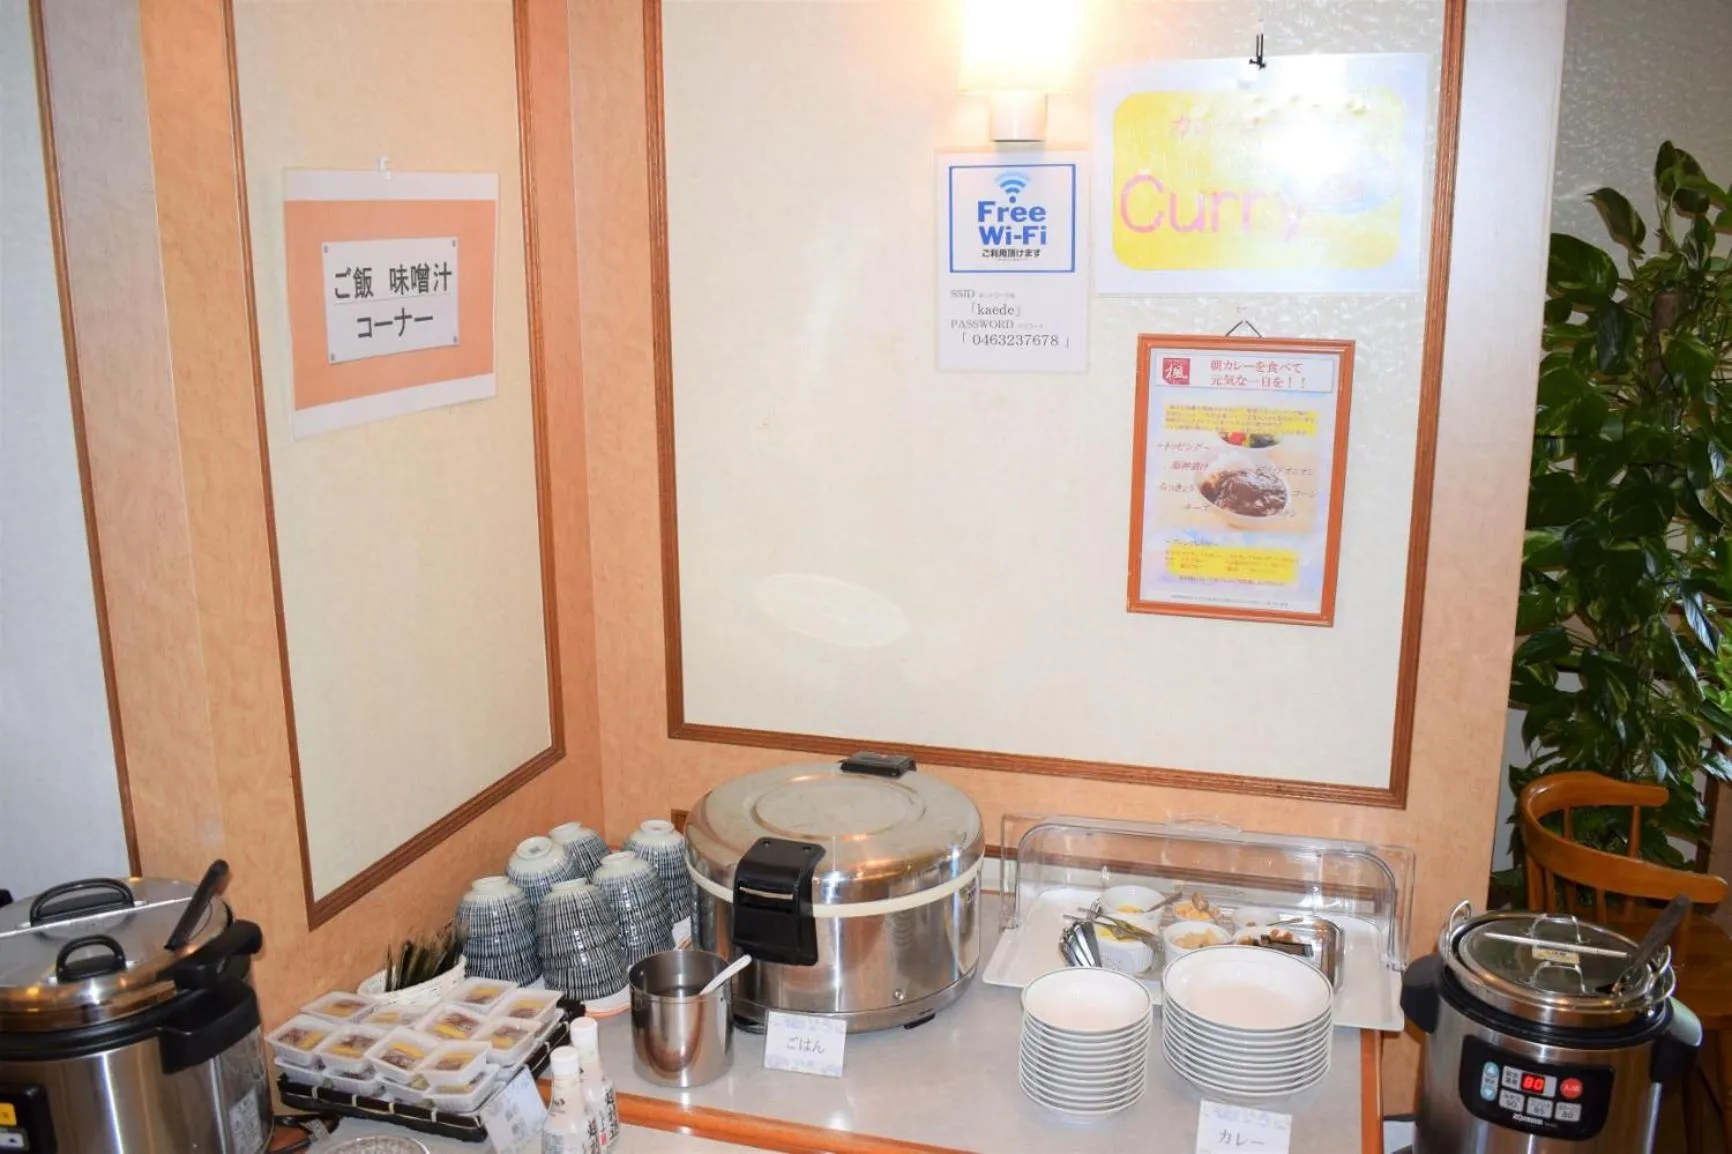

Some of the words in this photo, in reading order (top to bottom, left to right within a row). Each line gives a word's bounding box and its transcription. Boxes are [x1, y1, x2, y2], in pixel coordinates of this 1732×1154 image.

[977, 200, 1046, 222] Free
[1120, 174, 1303, 242] Curry
[978, 225, 1047, 245] Wi-Fi
[982, 248, 1040, 258] ご利用頂けます
[335, 267, 374, 298] ご飯
[389, 261, 452, 295] 味噌汁
[950, 289, 975, 298] SSID
[356, 307, 434, 338] コーナー
[950, 319, 1014, 329] PASSWORD
[1209, 359, 1304, 374] 朝カレーを食べて
[785, 1036, 825, 1054] ごはん
[1217, 1129, 1265, 1147] カレー
